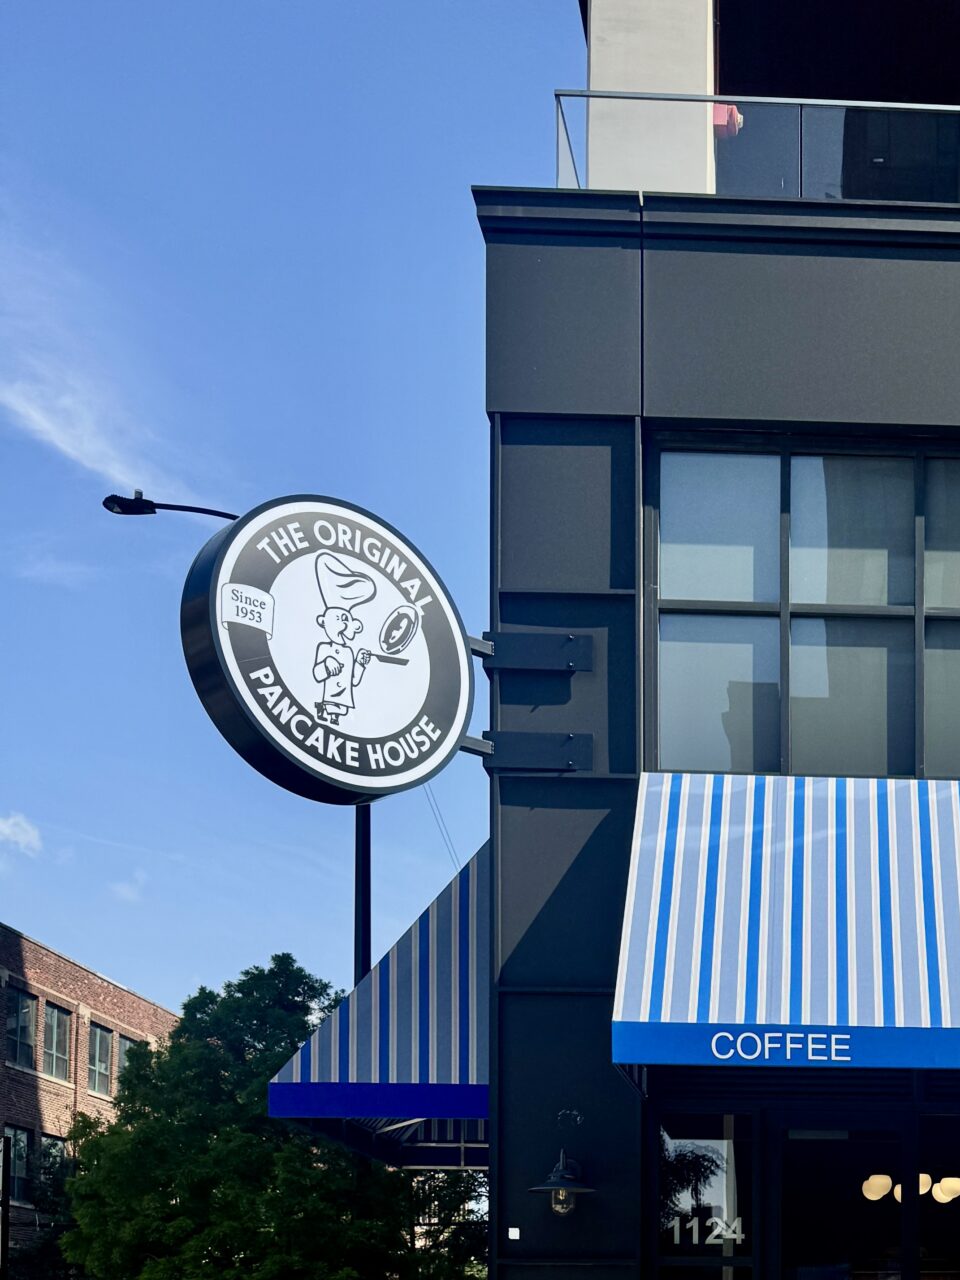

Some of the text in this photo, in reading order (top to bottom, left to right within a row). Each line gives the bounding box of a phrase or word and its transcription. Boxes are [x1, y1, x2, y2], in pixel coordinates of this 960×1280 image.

[256, 520, 433, 616] THE ORIGINAL
[231, 589, 266, 610] Since
[234, 605, 262, 624] 1953
[249, 666, 442, 769] PANCAKE HOUSE
[710, 1031, 852, 1061] COFFEE
[667, 1217, 745, 1244] 1124
